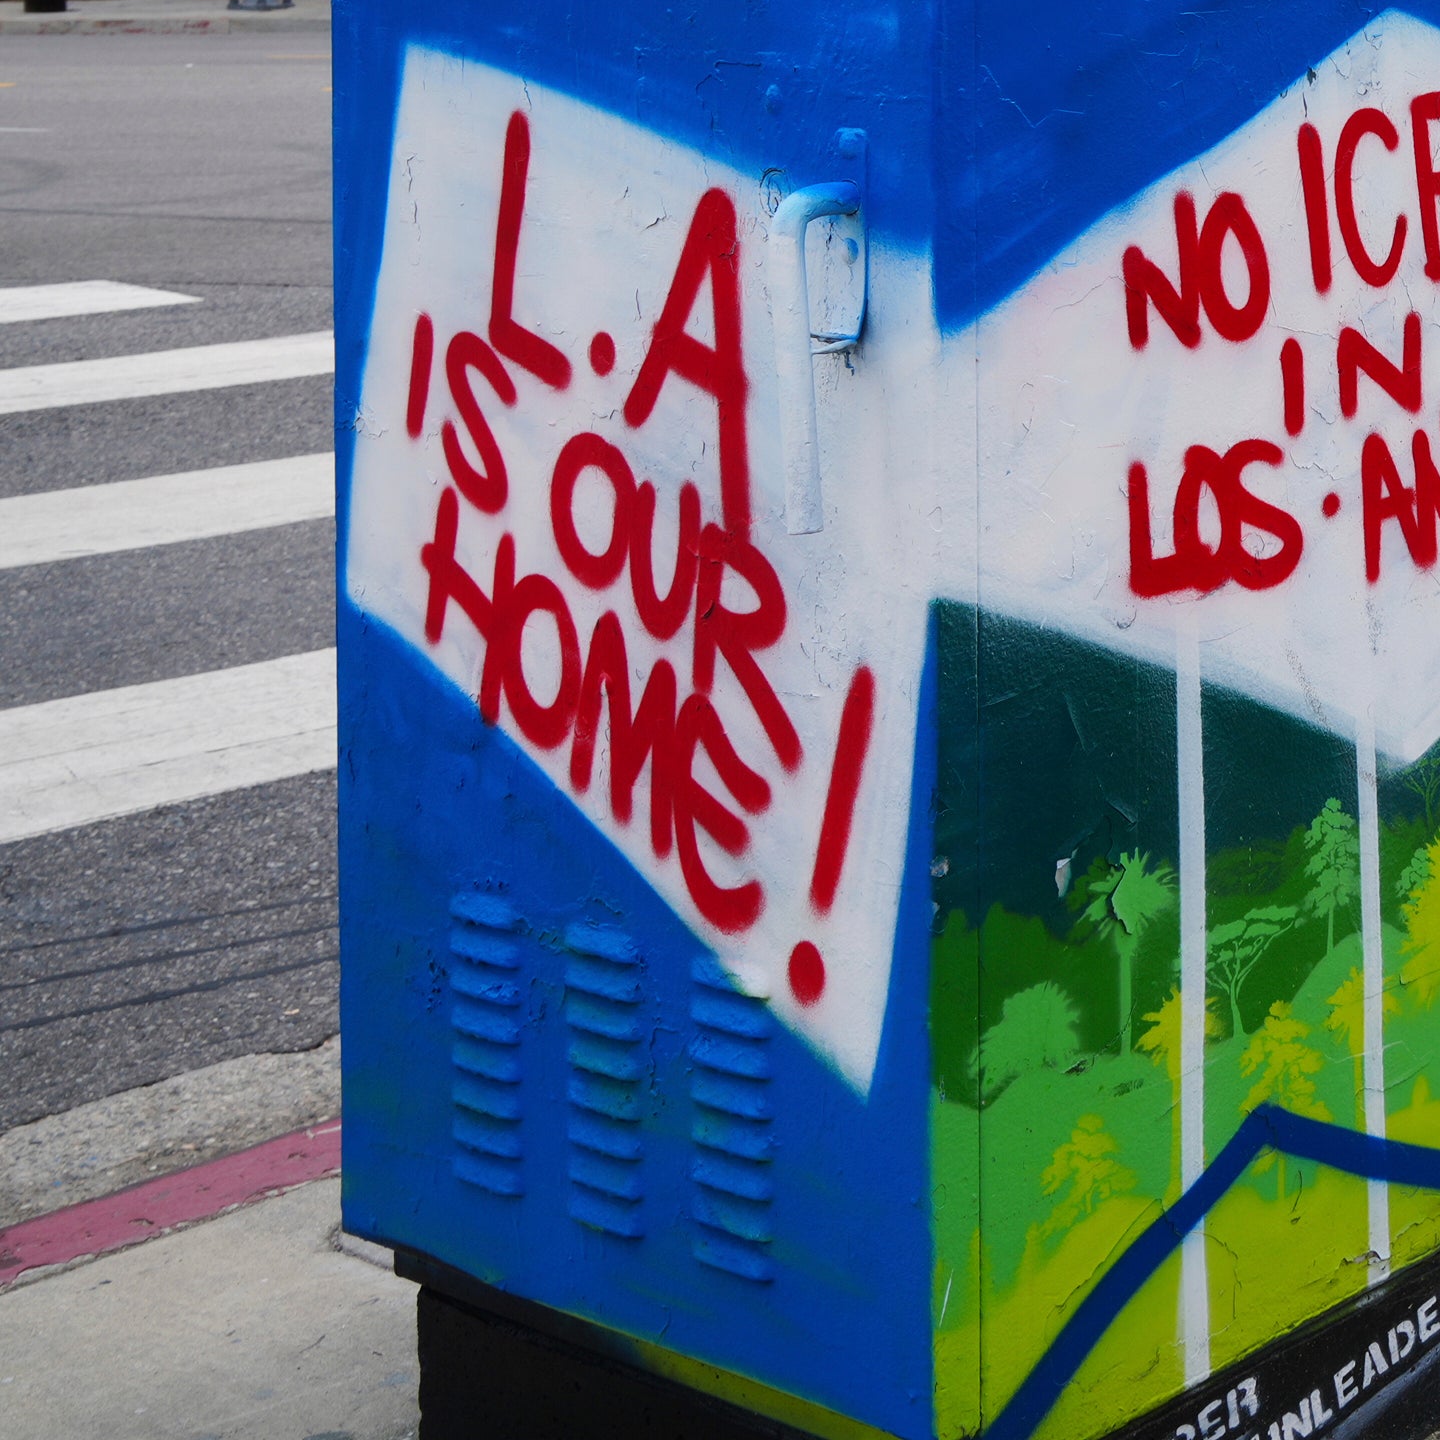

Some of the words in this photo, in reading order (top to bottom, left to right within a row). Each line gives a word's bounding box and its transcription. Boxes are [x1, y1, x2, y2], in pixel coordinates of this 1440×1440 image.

[1121, 188, 1272, 351] NO
[1280, 311, 1422, 436] IN
[1127, 438, 1304, 599] LOS
[550, 430, 803, 774] OUR
